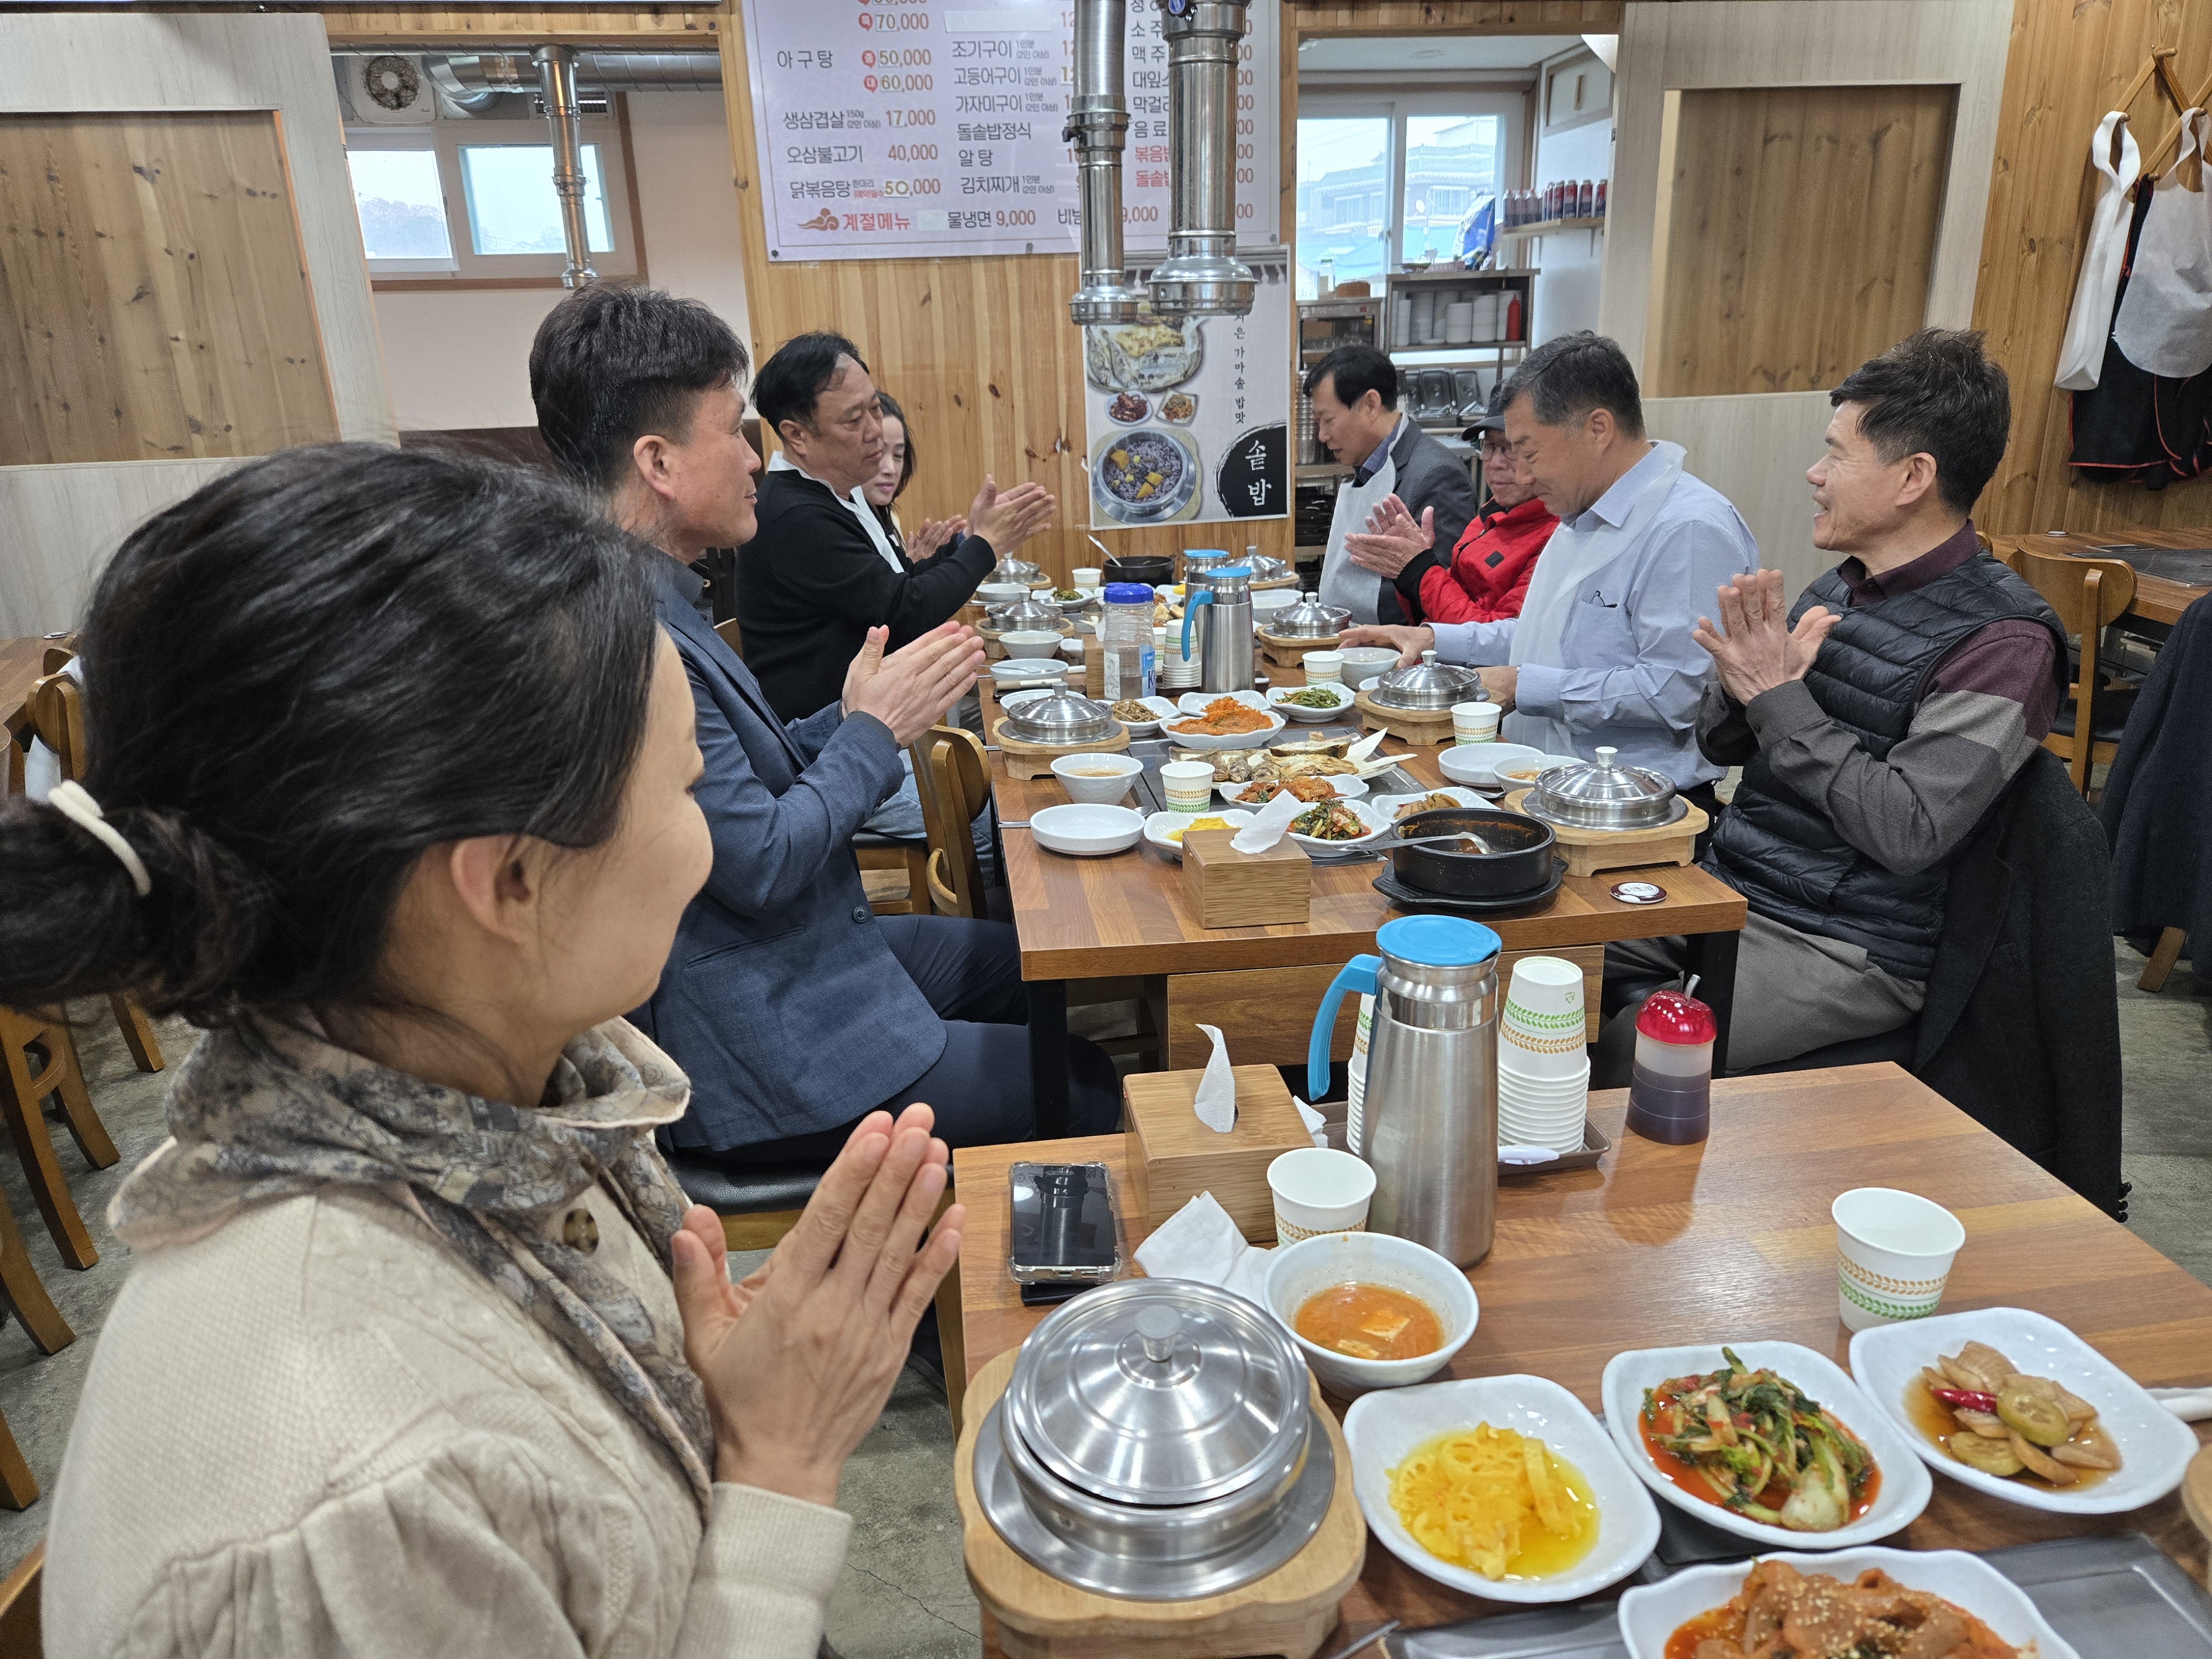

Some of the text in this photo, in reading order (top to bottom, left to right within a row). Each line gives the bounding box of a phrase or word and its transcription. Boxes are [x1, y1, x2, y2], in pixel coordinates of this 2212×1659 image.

[875, 13, 929, 32] 70,000
[879, 49, 932, 68] 50,000
[952, 40, 1012, 59] 조기구이
[881, 74, 933, 92] 60,000
[953, 66, 1021, 85] 고등어구이
[955, 95, 1022, 113] 가자미구이
[783, 111, 844, 130] 생삼겹살
[886, 109, 936, 128] 17,000
[957, 122, 1031, 141] 돌솥밥정식
[787, 144, 938, 164] 오삼불고기 40,000
[790, 180, 851, 199] 닭볶음탕
[885, 179, 940, 196] 50,000
[961, 176, 1019, 194] 김치찌개
[842, 212, 911, 232] 계절메뉴
[947, 211, 992, 229] 물냉면
[996, 210, 1036, 227] 9,000
